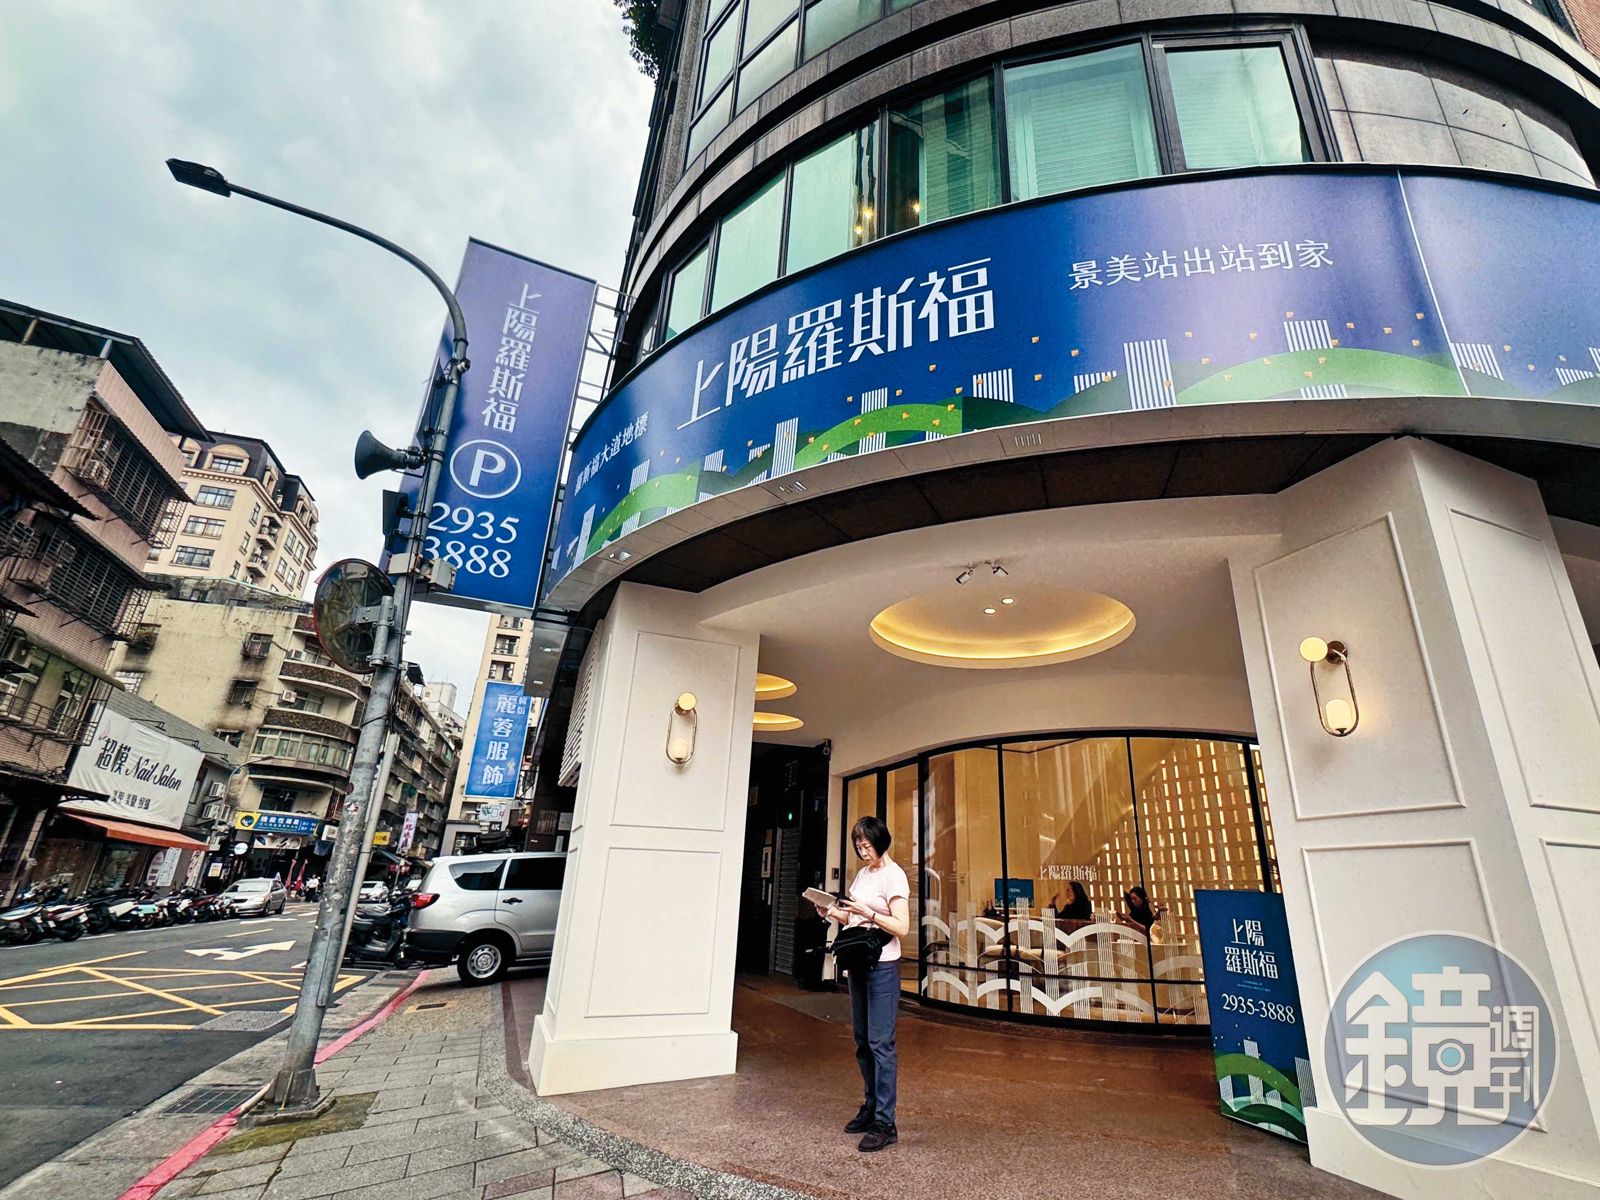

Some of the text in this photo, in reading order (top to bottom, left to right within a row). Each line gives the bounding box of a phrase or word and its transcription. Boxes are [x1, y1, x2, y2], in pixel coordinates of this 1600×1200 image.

[1068, 239, 1334, 291] 景美站出站到家
[480, 283, 542, 434] 上陽羅斯福
[677, 258, 996, 430] 上陽羅斯福
[469, 448, 507, 487] P
[428, 502, 520, 544] 2935
[95, 736, 182, 791] 超模 Nail Salon
[481, 694, 519, 786] 麗蓉服飾
[1230, 918, 1265, 947] 上陽
[1224, 946, 1279, 979] 羅斯福
[1221, 993, 1296, 1024] 2935-3888
